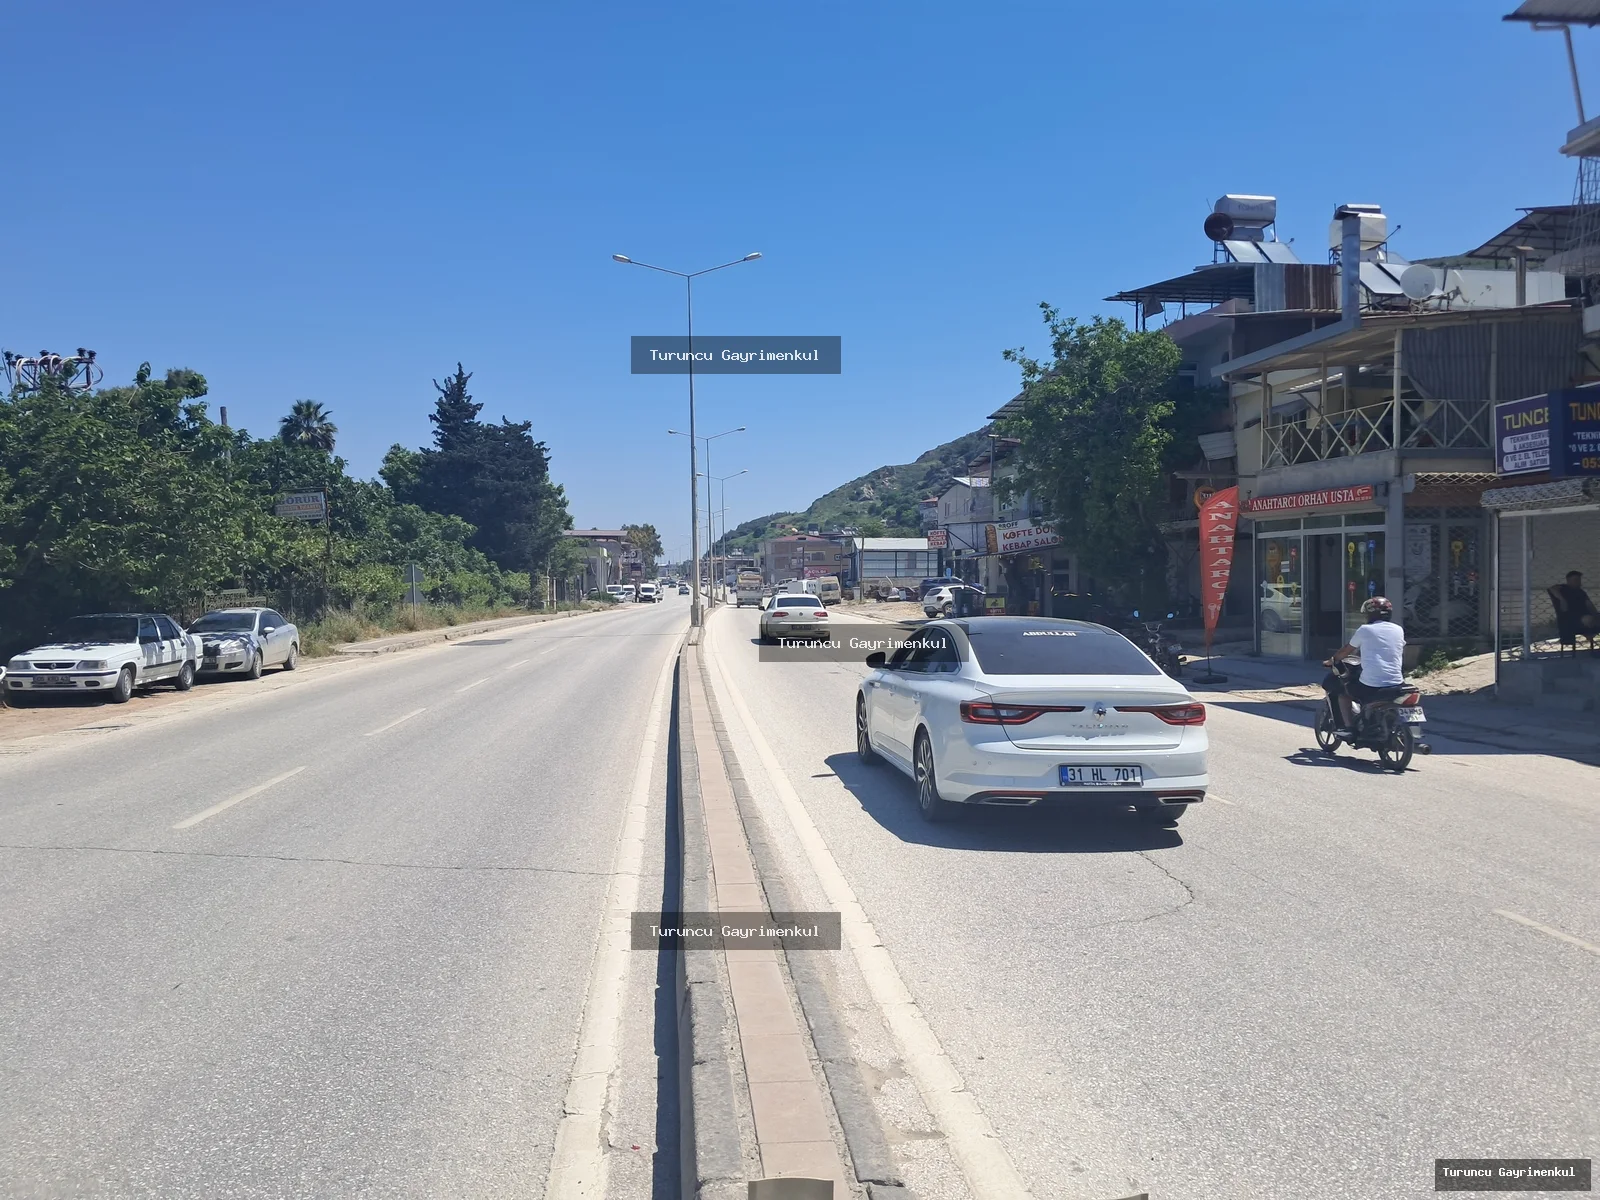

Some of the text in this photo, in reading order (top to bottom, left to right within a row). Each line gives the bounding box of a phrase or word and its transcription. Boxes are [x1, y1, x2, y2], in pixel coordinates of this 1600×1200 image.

[1578, 443, 1588, 452] VE
[1509, 454, 1517, 462] VE
[1252, 489, 1355, 511] ANAHTARCI ORHAN USTA
[1002, 540, 1032, 551] KEBAP
[1207, 501, 1235, 600] ANAHTARCI
[1069, 768, 1136, 782] 31 HL 701
